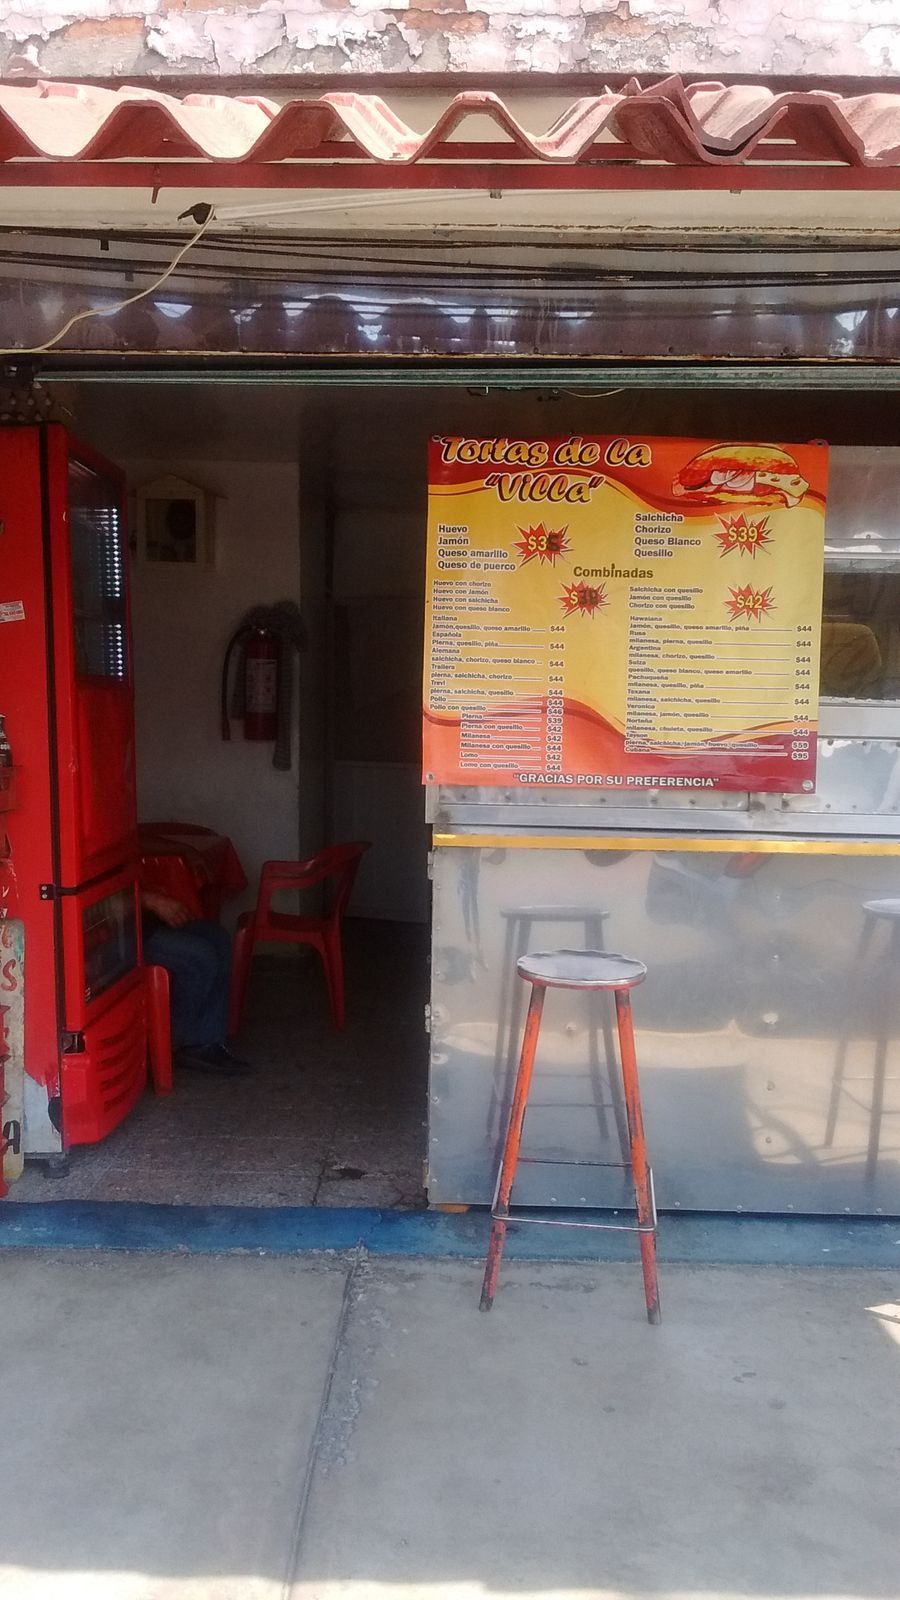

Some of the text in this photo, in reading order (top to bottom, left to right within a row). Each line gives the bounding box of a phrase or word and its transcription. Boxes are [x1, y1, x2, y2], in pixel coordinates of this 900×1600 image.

[441, 435, 549, 467] Tortas
[554, 437, 600, 466] de
[635, 513, 683, 522] Salchicha
[438, 525, 468, 534] Huevo
[635, 525, 671, 534] Chorizo
[728, 526, 758, 543] $39
[438, 536, 469, 545] Jamón
[634, 537, 701, 546] Queso Blanco
[438, 549, 508, 558] Queso amarillo
[634, 549, 673, 558] Quesillo
[438, 561, 516, 572] Queso de puerco
[573, 564, 654, 579] Combinadas
[736, 595, 763, 609] $42
[577, 775, 604, 785] POR
[606, 776, 624, 786] SU
